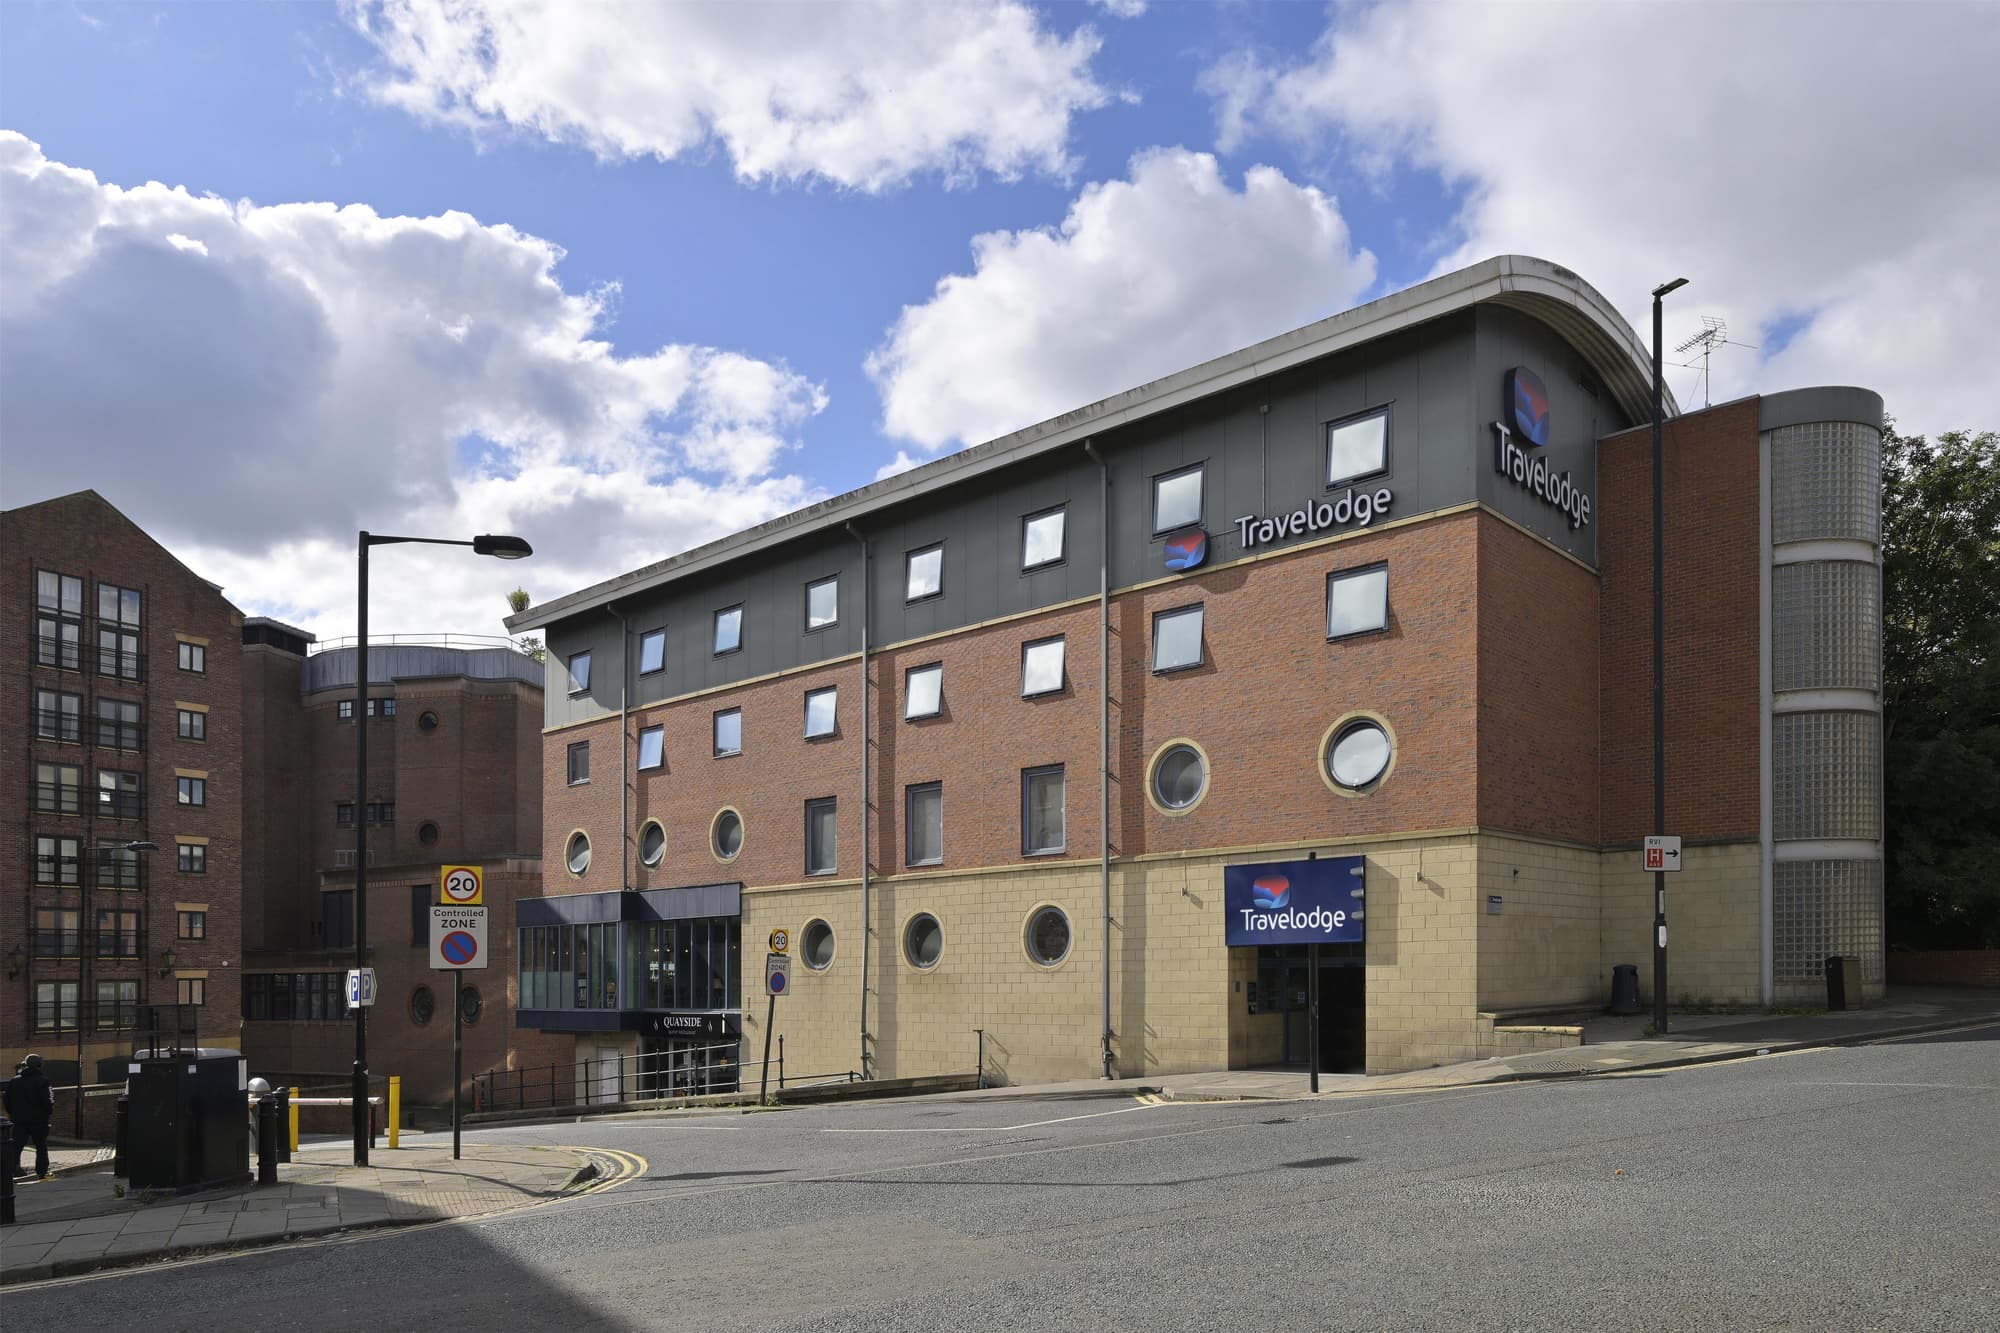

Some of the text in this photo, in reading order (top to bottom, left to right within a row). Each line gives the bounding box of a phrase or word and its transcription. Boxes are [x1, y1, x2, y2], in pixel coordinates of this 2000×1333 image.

[1496, 421, 1590, 529] Travelodge
[1235, 488, 1392, 548] Travelodge
[1651, 849, 1660, 862] H
[449, 877, 475, 892] 20
[433, 909, 484, 917] Controlled
[1240, 905, 1346, 933] Travelodge
[441, 919, 477, 929] ZONE
[775, 935, 786, 945] 20
[663, 1016, 702, 1029] QUAYSIDE
